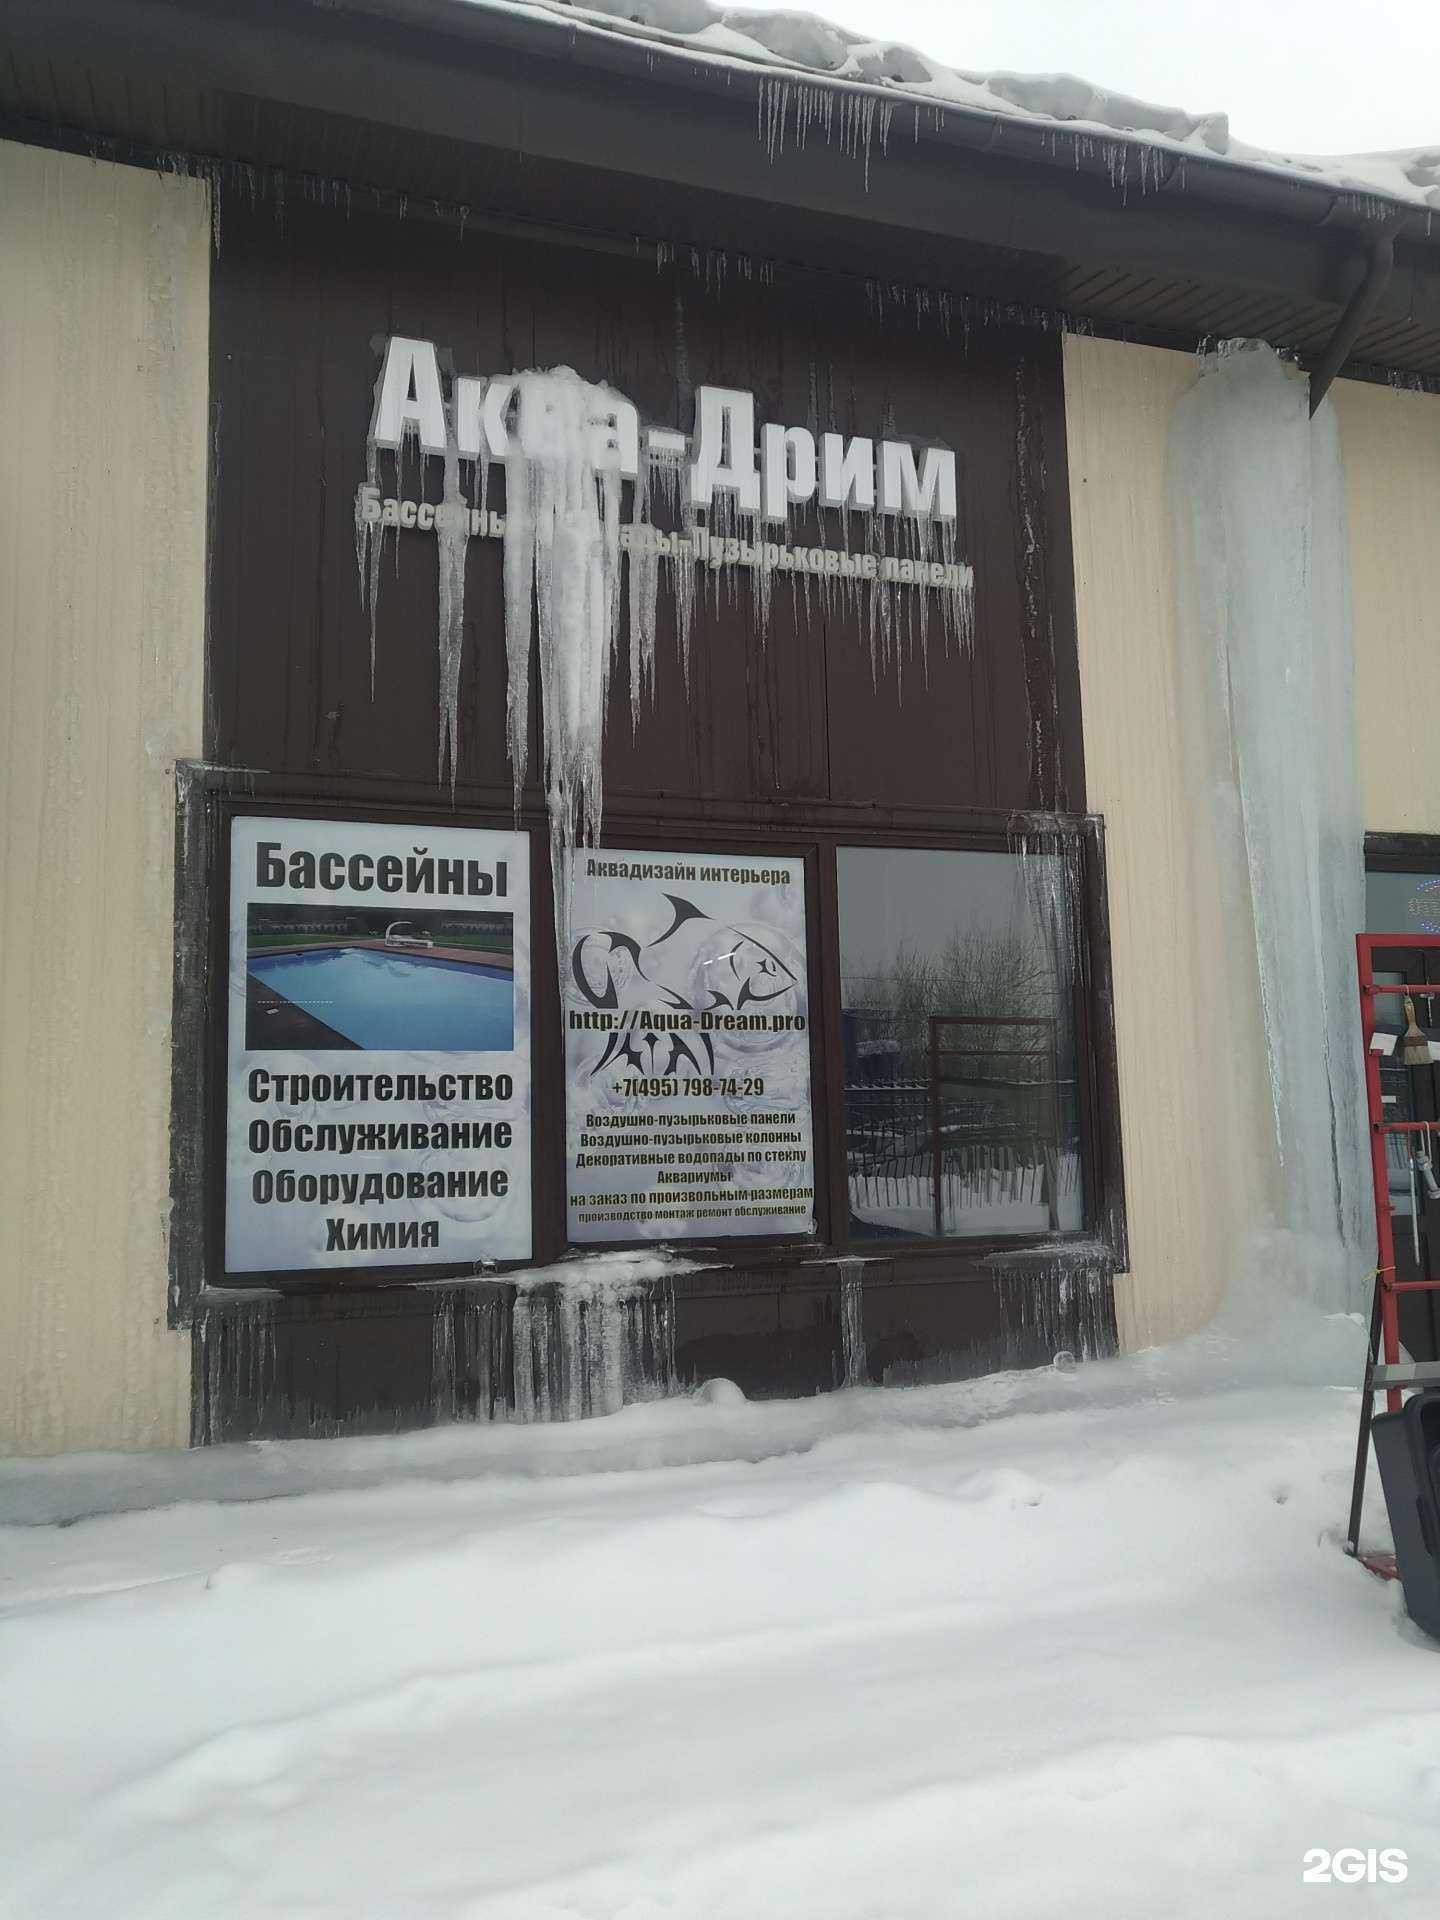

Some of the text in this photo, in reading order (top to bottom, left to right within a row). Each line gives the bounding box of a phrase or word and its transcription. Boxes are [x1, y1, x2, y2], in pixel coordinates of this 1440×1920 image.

[256, 841, 508, 897] Бассейны
[586, 858, 791, 885] Аквадизайн интерьера
[569, 1010, 806, 1033] http://Aqua-Dream.pro
[248, 1069, 513, 1105] Строительство
[612, 1078, 764, 1097] +7(495) 798-74-29
[586, 1113, 796, 1128] Воздушно-пузырьковые панели
[248, 1119, 513, 1155] Обслуживание
[580, 1131, 801, 1147] Воздушно-пузырьковые колонны
[576, 1150, 807, 1168] Декоративные водопады по стеклу
[252, 1168, 509, 1205] Оборудование
[657, 1170, 733, 1184] Аквариумы
[570, 1187, 813, 1207] на заказ по произвольным размерам
[578, 1205, 806, 1223] производство монтаж ремонт обслуживание
[326, 1218, 440, 1251] Химия
